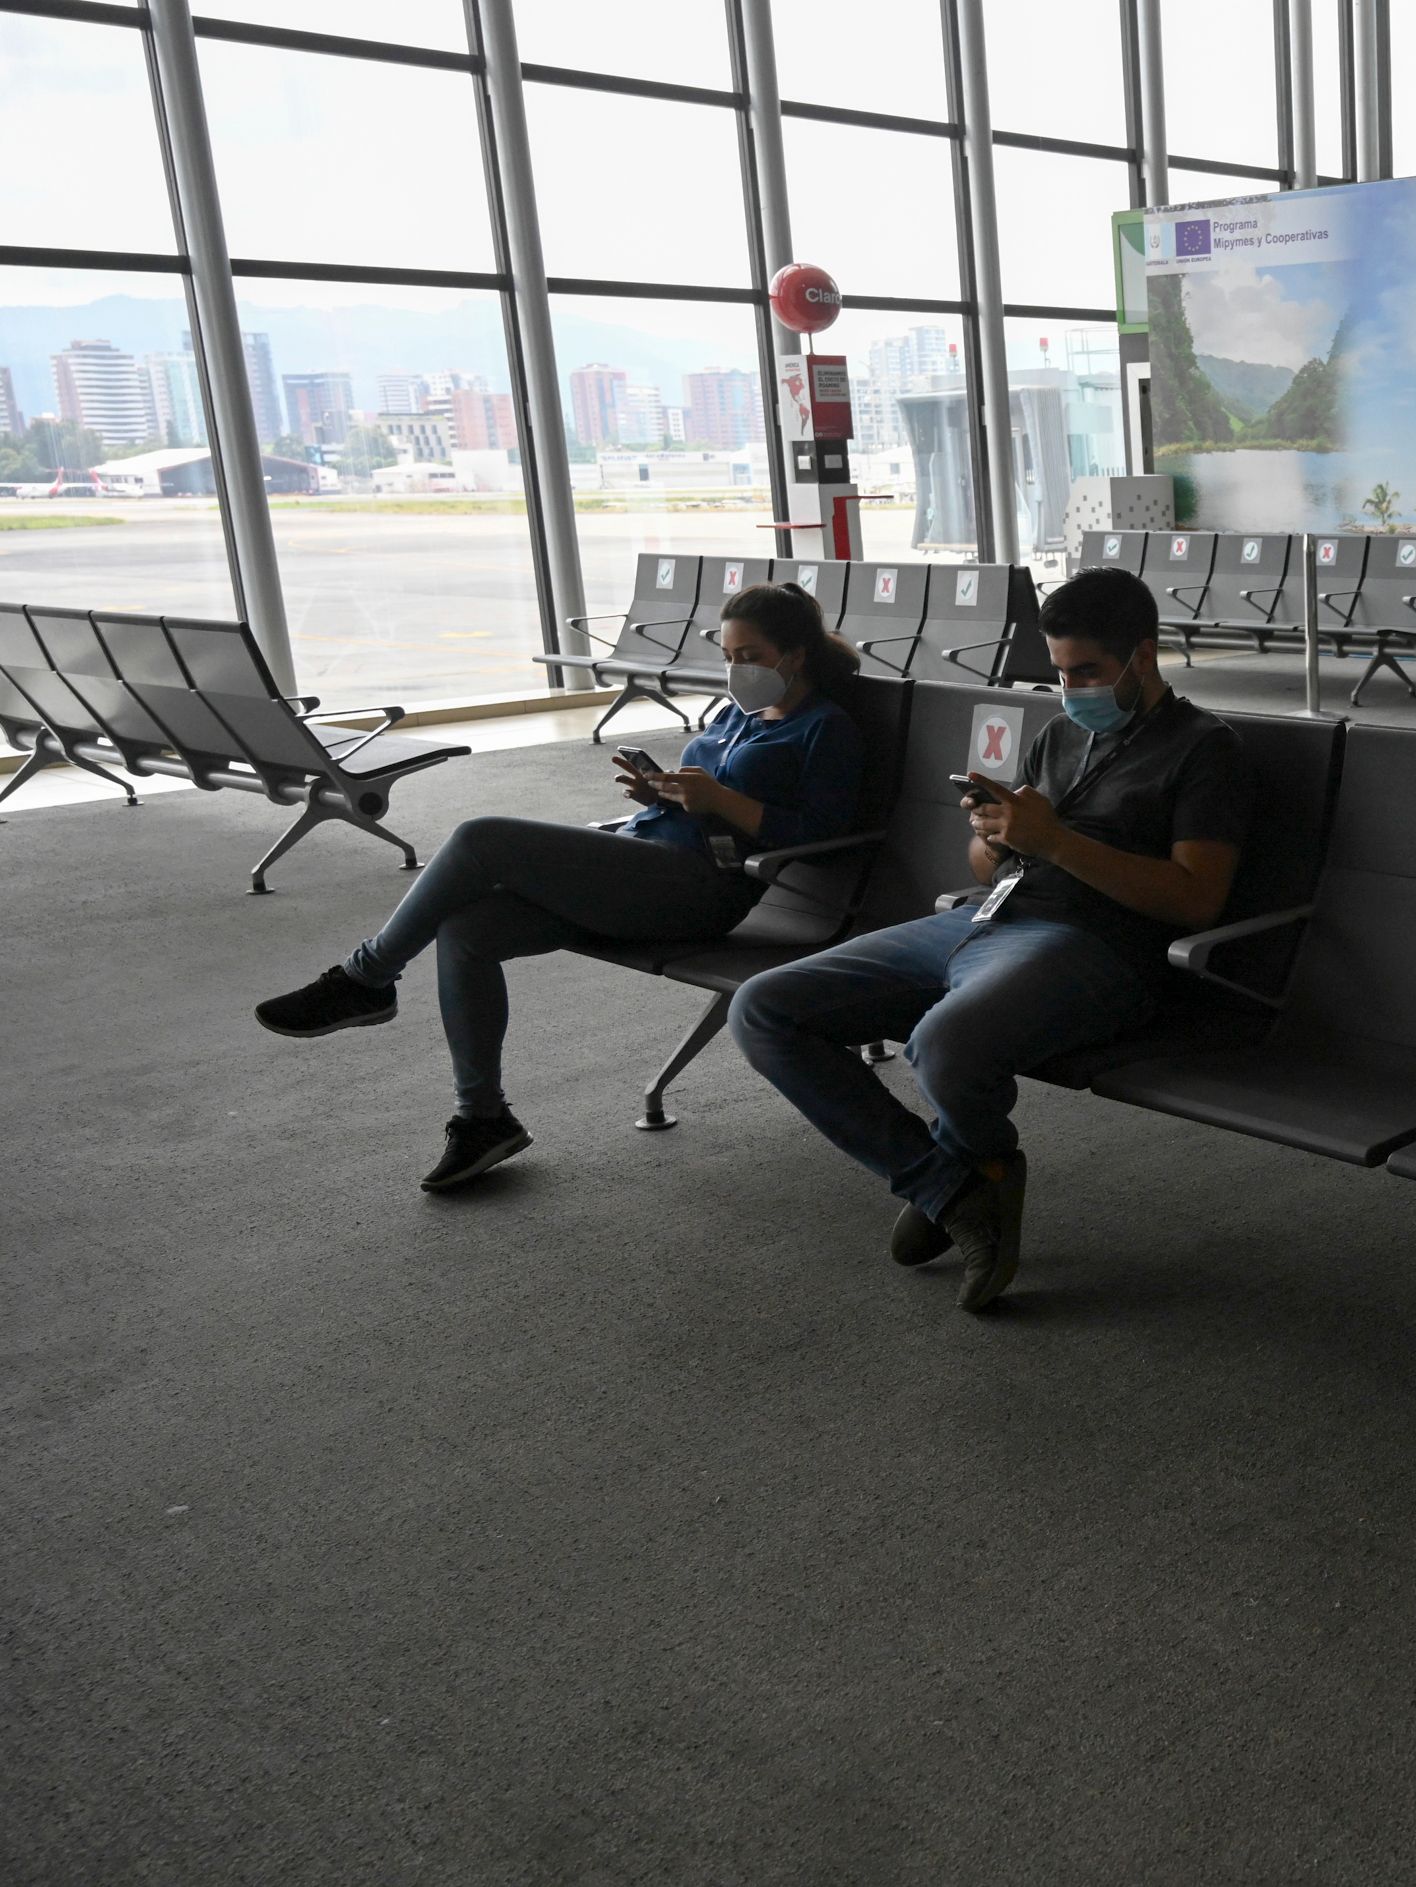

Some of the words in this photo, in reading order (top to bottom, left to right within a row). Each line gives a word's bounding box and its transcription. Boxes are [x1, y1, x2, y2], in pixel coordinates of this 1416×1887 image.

[1213, 220, 1258, 233] Programa
[1213, 238, 1255, 250] Mipymes
[1257, 237, 1263, 248] y
[1265, 229, 1329, 245] Cooperativas
[805, 288, 842, 305] Claro
